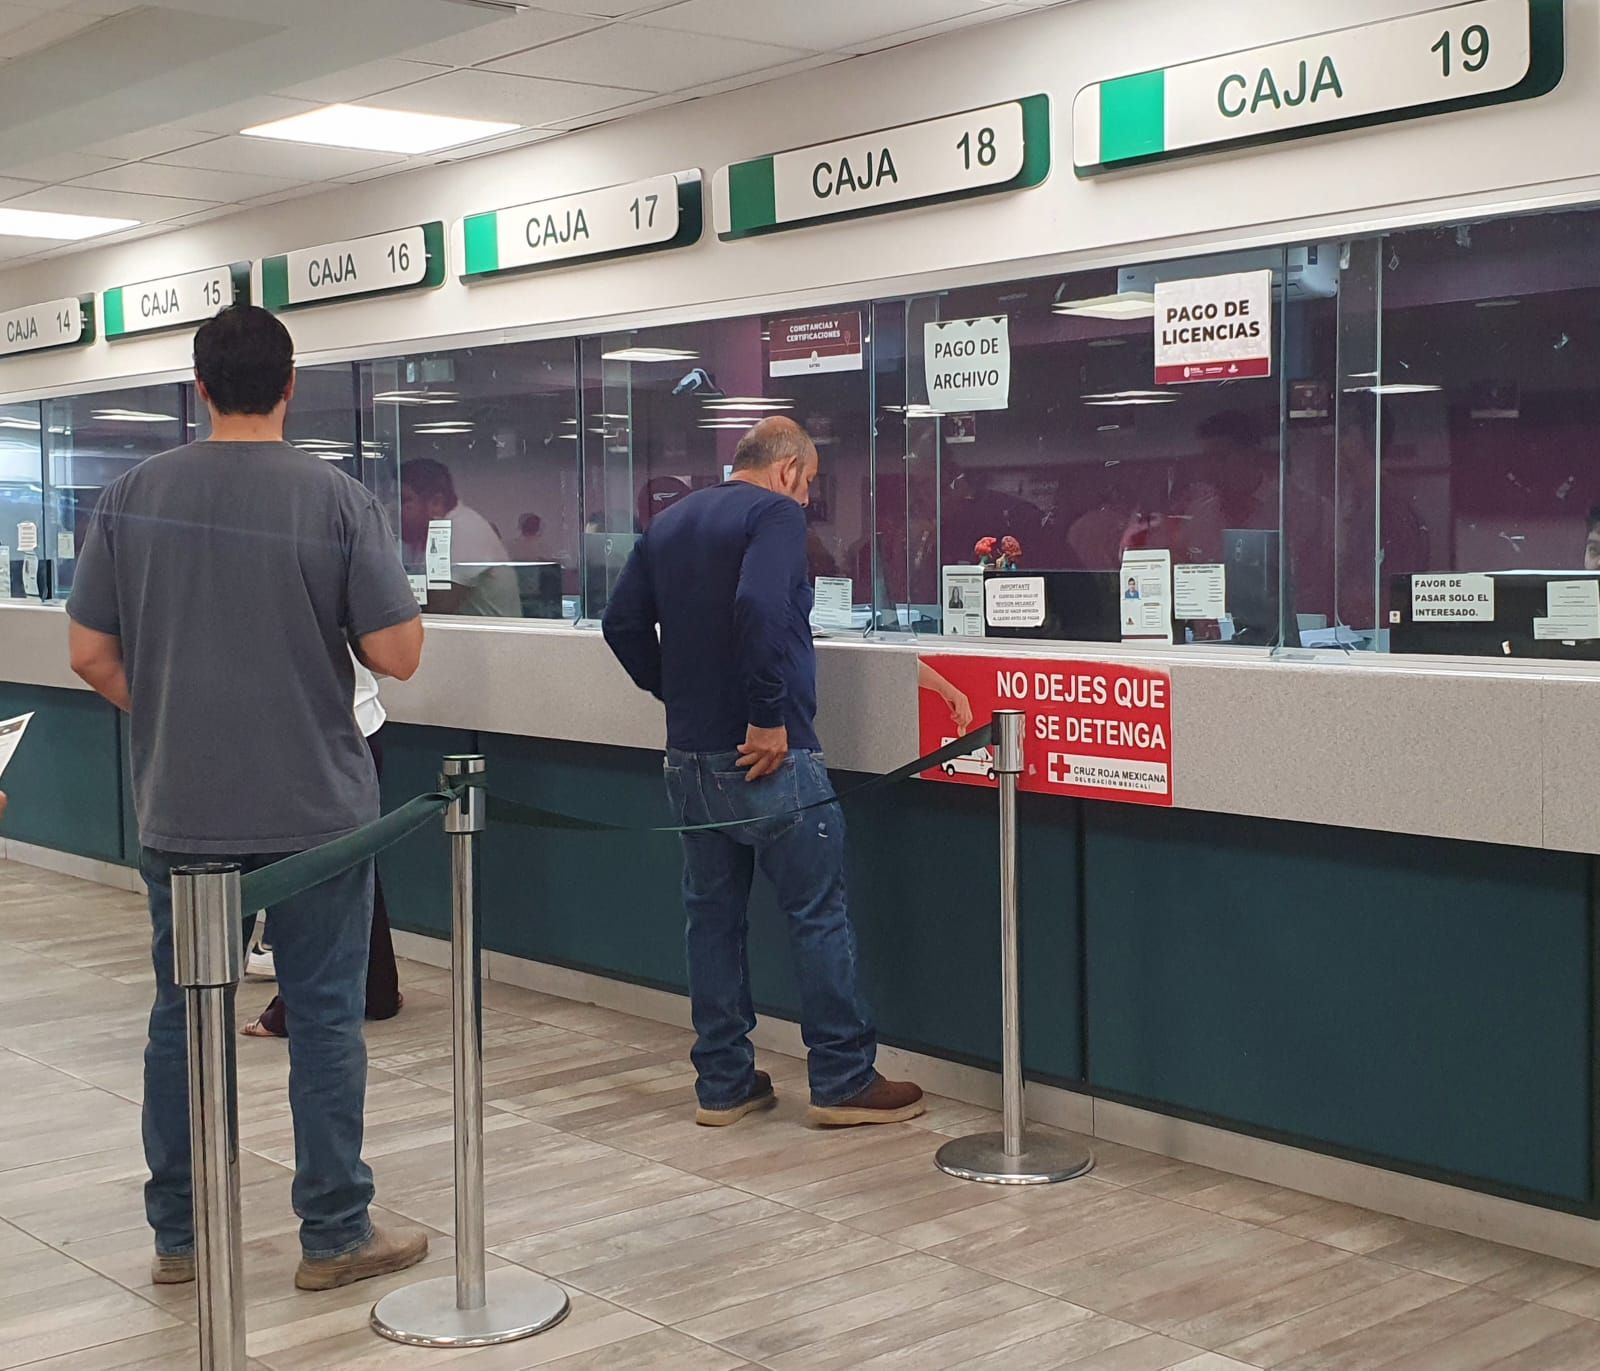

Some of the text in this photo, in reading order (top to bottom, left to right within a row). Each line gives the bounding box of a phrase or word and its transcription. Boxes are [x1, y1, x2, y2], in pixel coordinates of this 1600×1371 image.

[1217, 25, 1489, 117] CAJA 19
[812, 127, 996, 198] CAJA 18
[525, 195, 659, 248] CAJA 17
[308, 243, 410, 287] CAJA 16
[141, 280, 221, 317] CAJA 15
[1167, 300, 1249, 323] PAGO DE
[7, 310, 71, 342] CAJA 14
[786, 330, 840, 342] CERTIFICACIONES
[790, 321, 833, 333] CONSTANCIAS
[1162, 321, 1260, 345] LICENCIAS
[935, 337, 999, 359] PAGO DE
[934, 369, 999, 390] ARCHIVO
[1414, 580, 1462, 588] FAVOR DE
[1414, 594, 1489, 602] PASAR SOLO EL
[1415, 609, 1478, 617] INTERESADO.
[997, 671, 1165, 708] NO DEJES QUE
[1035, 714, 1166, 749] SE DETENGA
[1074, 766, 1166, 783] CRUZ ROJA MEXICANA
